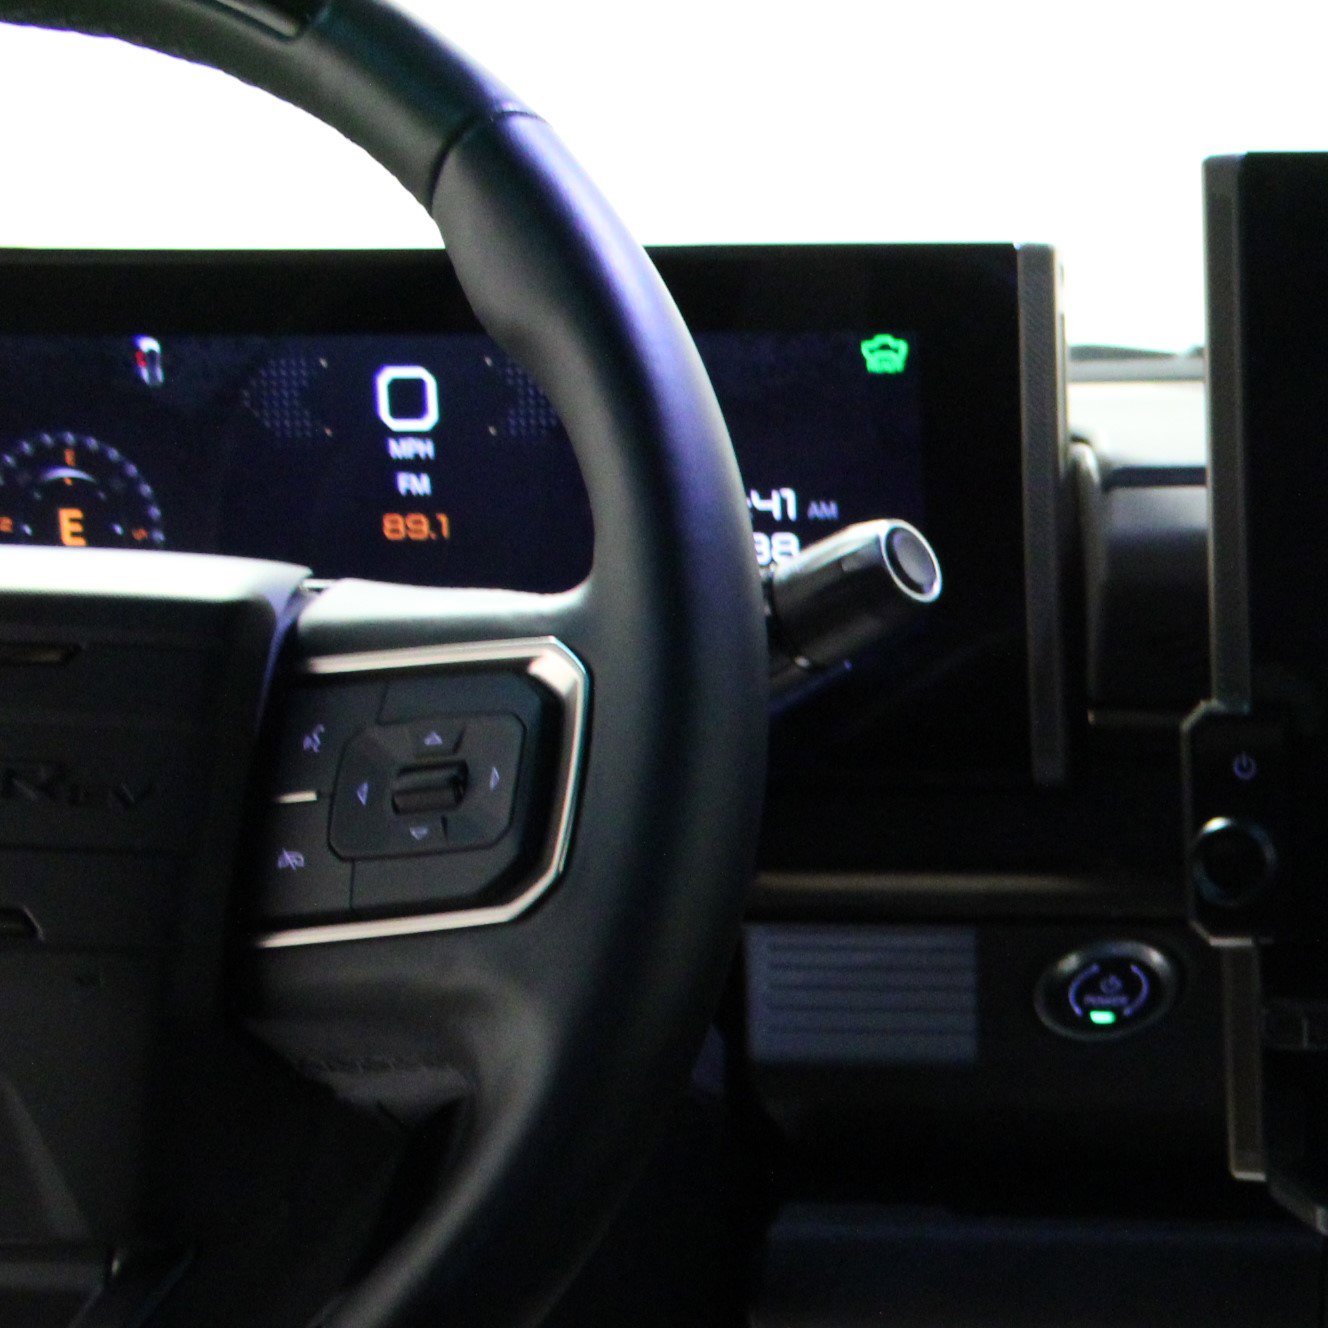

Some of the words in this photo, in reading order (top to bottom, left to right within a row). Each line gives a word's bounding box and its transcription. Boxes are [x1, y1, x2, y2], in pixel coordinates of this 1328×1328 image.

[387, 437, 435, 460] MPH
[395, 471, 432, 496] FM
[807, 500, 839, 521] AM
[58, 508, 87, 547] E
[382, 512, 450, 541] 89.1
